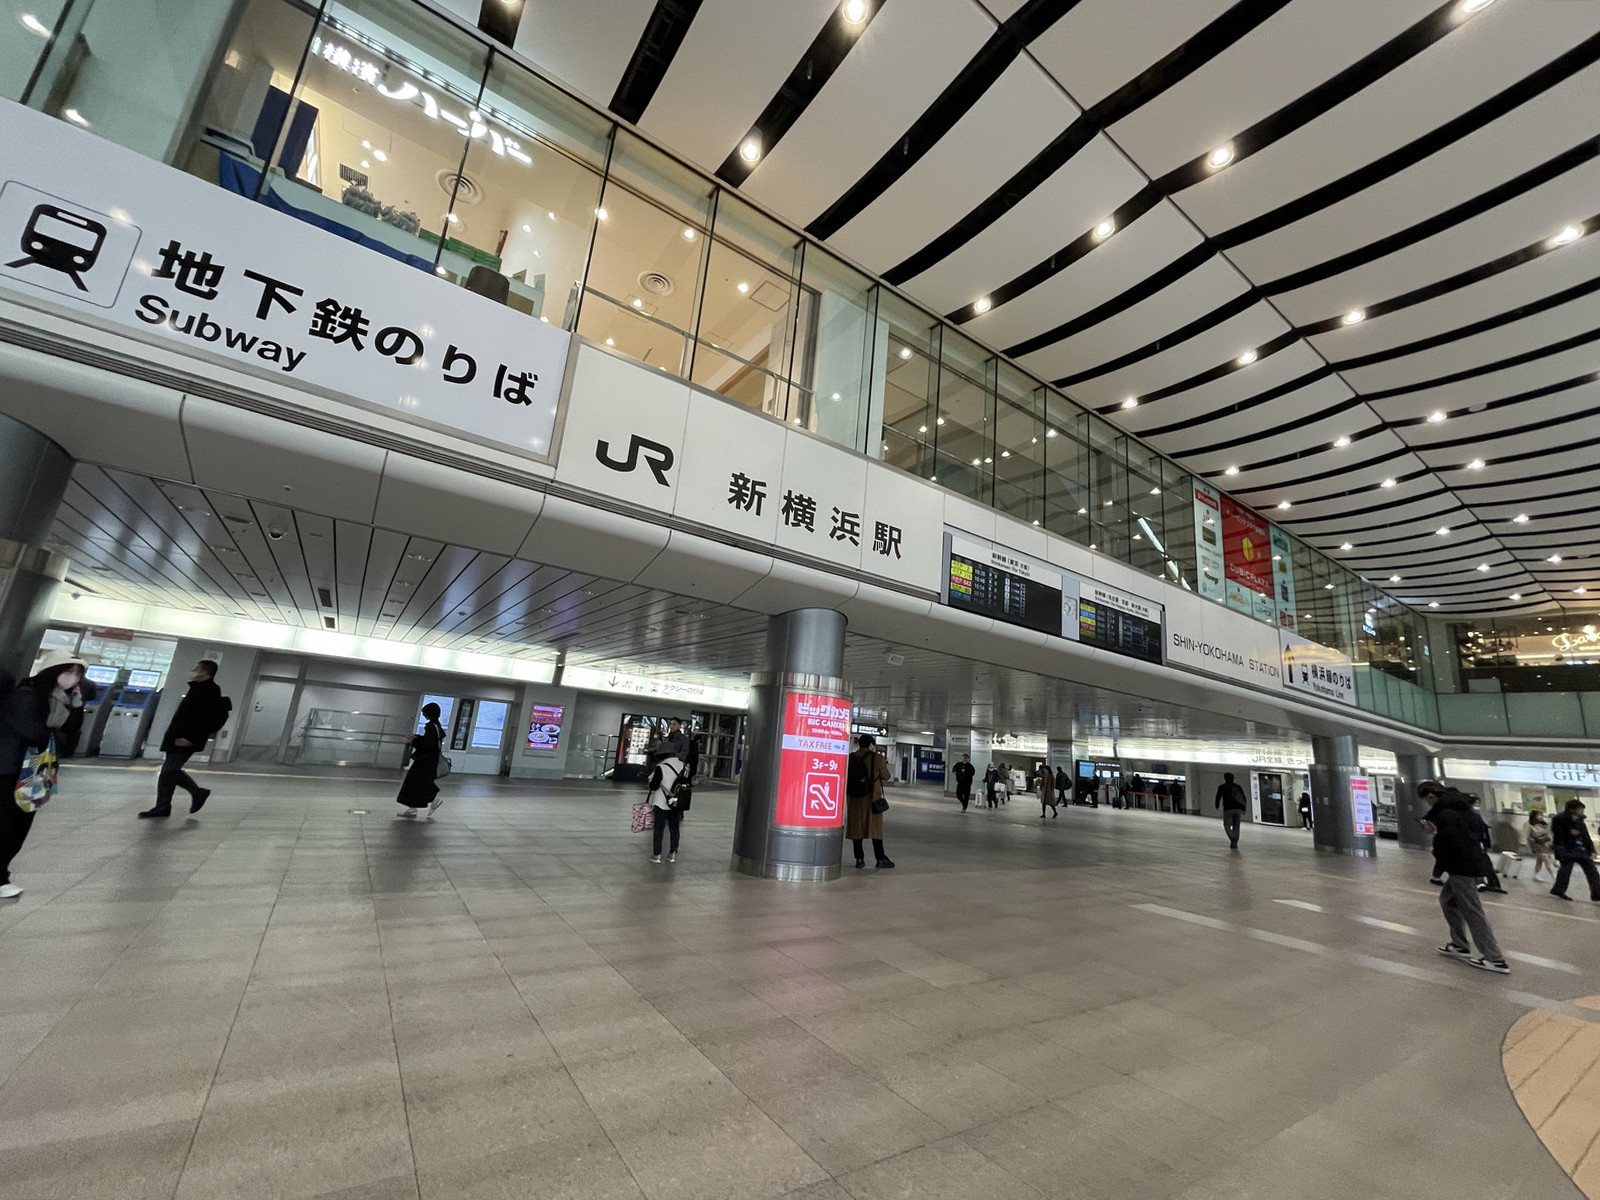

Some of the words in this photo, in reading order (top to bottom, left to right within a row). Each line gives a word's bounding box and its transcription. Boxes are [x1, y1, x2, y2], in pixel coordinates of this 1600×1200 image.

[135, 294, 307, 372] Subway
[151, 240, 539, 407] 地下鉄のりば
[596, 433, 675, 488] JR
[727, 472, 904, 560] 新横浜駅
[1173, 633, 1245, 667] SHIN-YOKOHAMA
[1249, 658, 1280, 679] STATION
[808, 718, 821, 727] BIC
